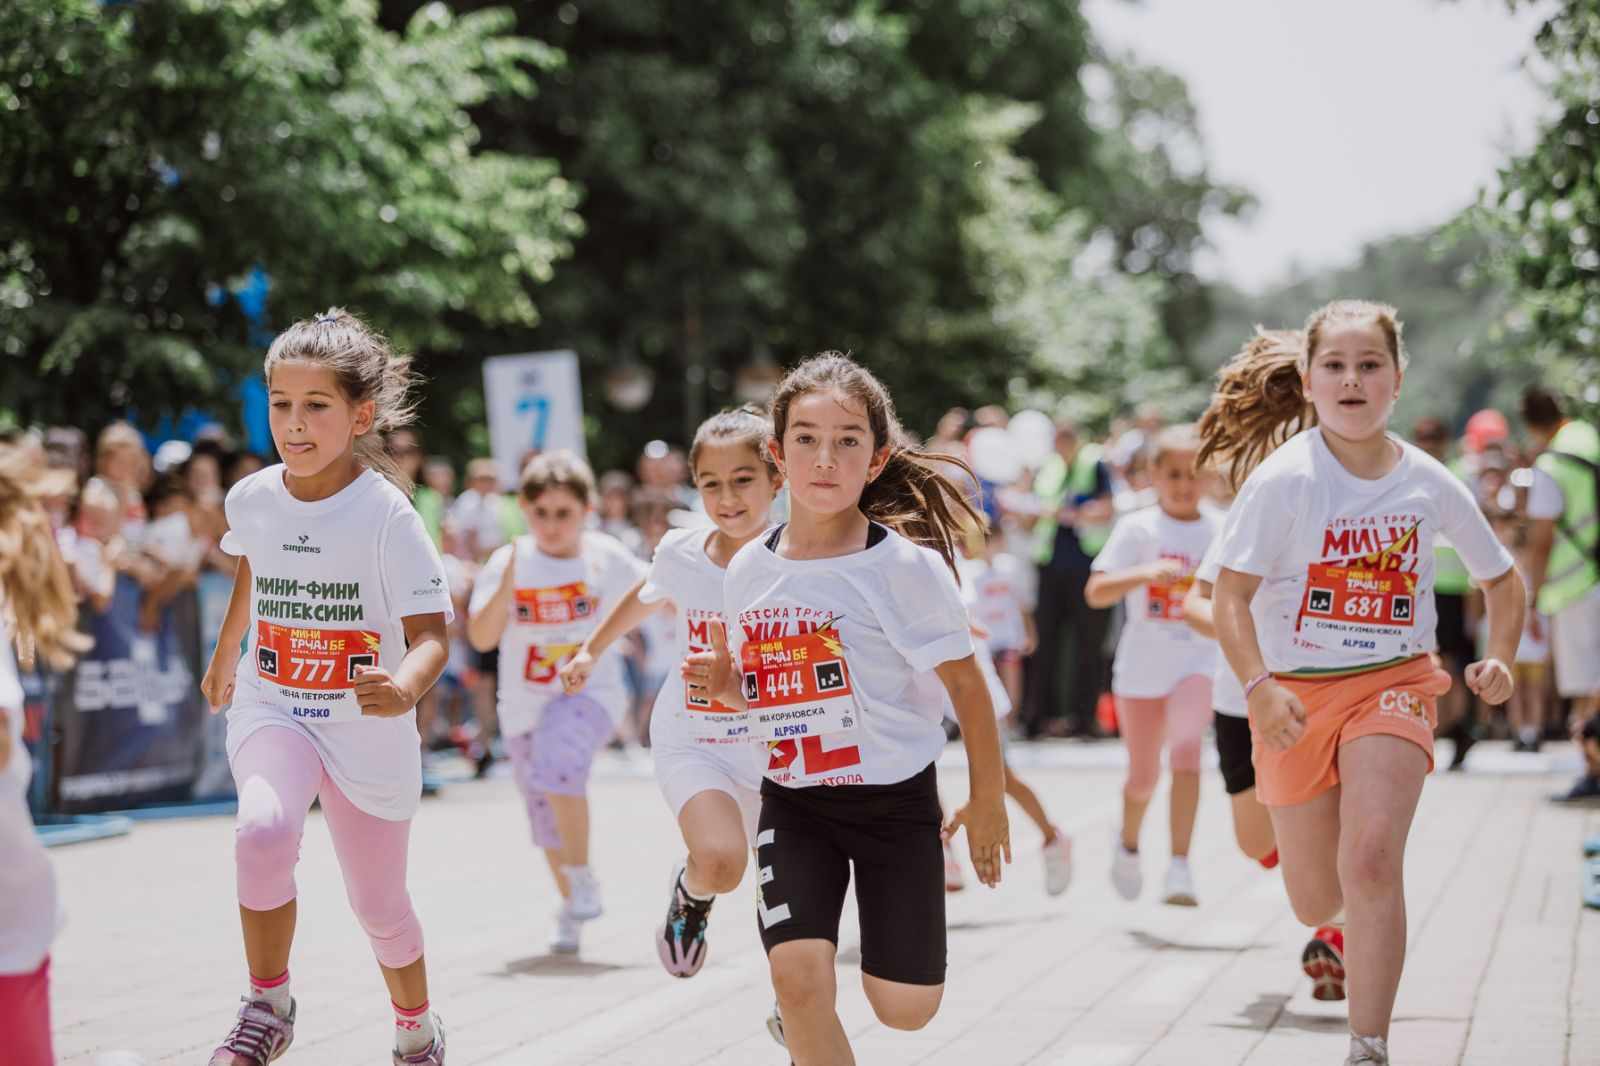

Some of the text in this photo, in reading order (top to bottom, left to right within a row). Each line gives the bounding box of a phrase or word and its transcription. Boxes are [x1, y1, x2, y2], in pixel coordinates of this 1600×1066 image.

[516, 396, 551, 451] 7
[256, 576, 360, 600] МИНИ-ФИНИ
[257, 599, 364, 622] СИНПЕКСИНИ
[1344, 596, 1384, 618] 681
[739, 608, 833, 624] ДЕТСКА ТРКА
[290, 629, 321, 639] МИНИ
[290, 638, 345, 650] ТРЧАЈ БЕ
[792, 647, 808, 661] БЕ
[290, 658, 336, 682] 777
[766, 670, 804, 698] 444
[293, 706, 330, 718] ALPSKO
[727, 726, 749, 736] ALPS
[774, 723, 808, 738] ALPSKO
